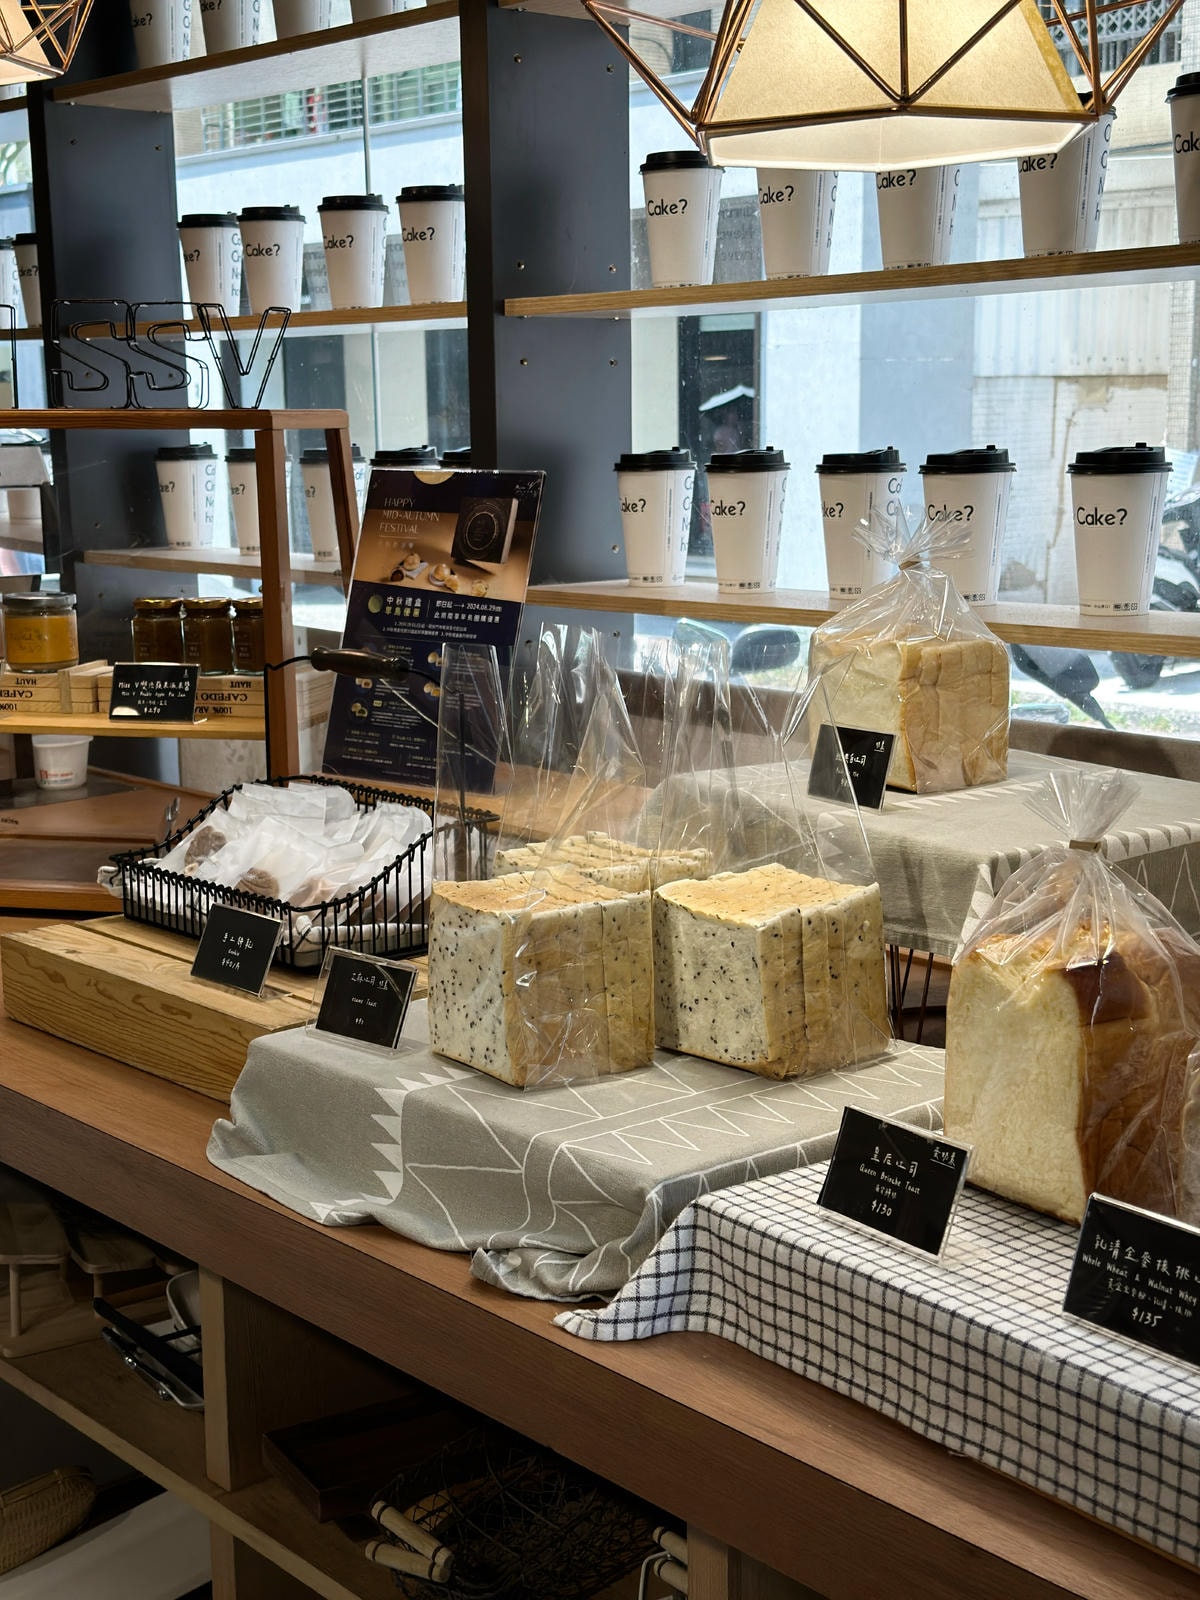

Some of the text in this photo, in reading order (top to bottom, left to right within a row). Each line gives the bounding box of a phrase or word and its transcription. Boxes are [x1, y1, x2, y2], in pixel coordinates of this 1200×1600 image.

[200, 0, 222, 13] ake?
[1174, 131, 1200, 154] Cak
[647, 198, 689, 217] Cake?
[245, 243, 281, 258] Cake?
[384, 497, 416, 508] HAPPY
[822, 502, 845, 519] ke?
[927, 504, 975, 523] Cake?
[1077, 506, 1129, 527] Cake?
[379, 522, 419, 534] FESTIVAL
[15, 677, 37, 686] HAUT
[229, 681, 252, 689] HAUT
[0, 689, 33, 699] CAFE
[870, 1146, 919, 1178] 皇后吐司
[871, 1199, 893, 1217] $130
[1131, 1306, 1164, 1327] $135
